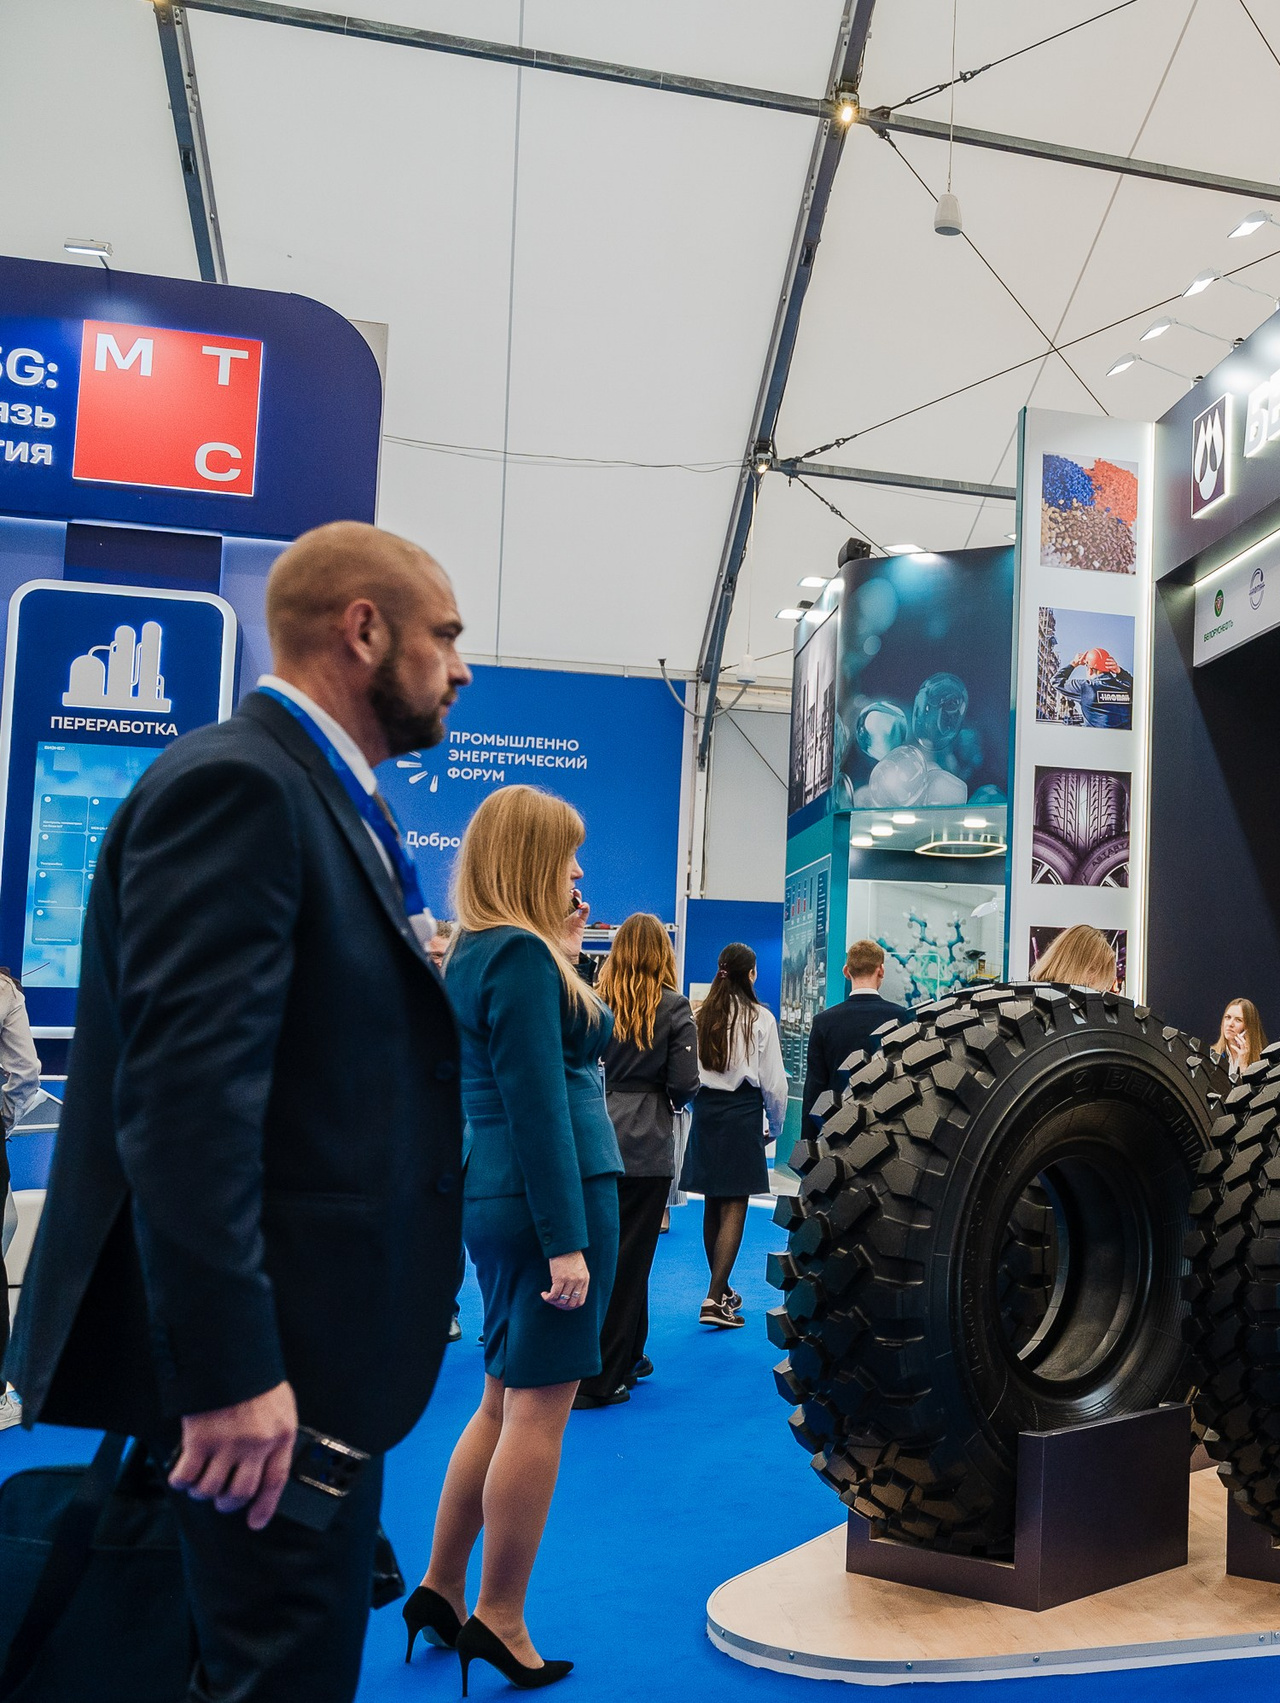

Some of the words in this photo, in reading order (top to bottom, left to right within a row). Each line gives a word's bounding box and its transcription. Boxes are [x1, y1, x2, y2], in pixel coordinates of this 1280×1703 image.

[0, 346, 58, 389] G:
[49, 715, 179, 737] ПЕРЕРАБОТКА
[449, 730, 580, 752] ПРОМЫШЛЕННО
[447, 749, 588, 770] ЭНЕРГЕТИЧЕСКИЙ
[447, 768, 505, 782] ФОРУМ
[406, 830, 461, 851] Добро
